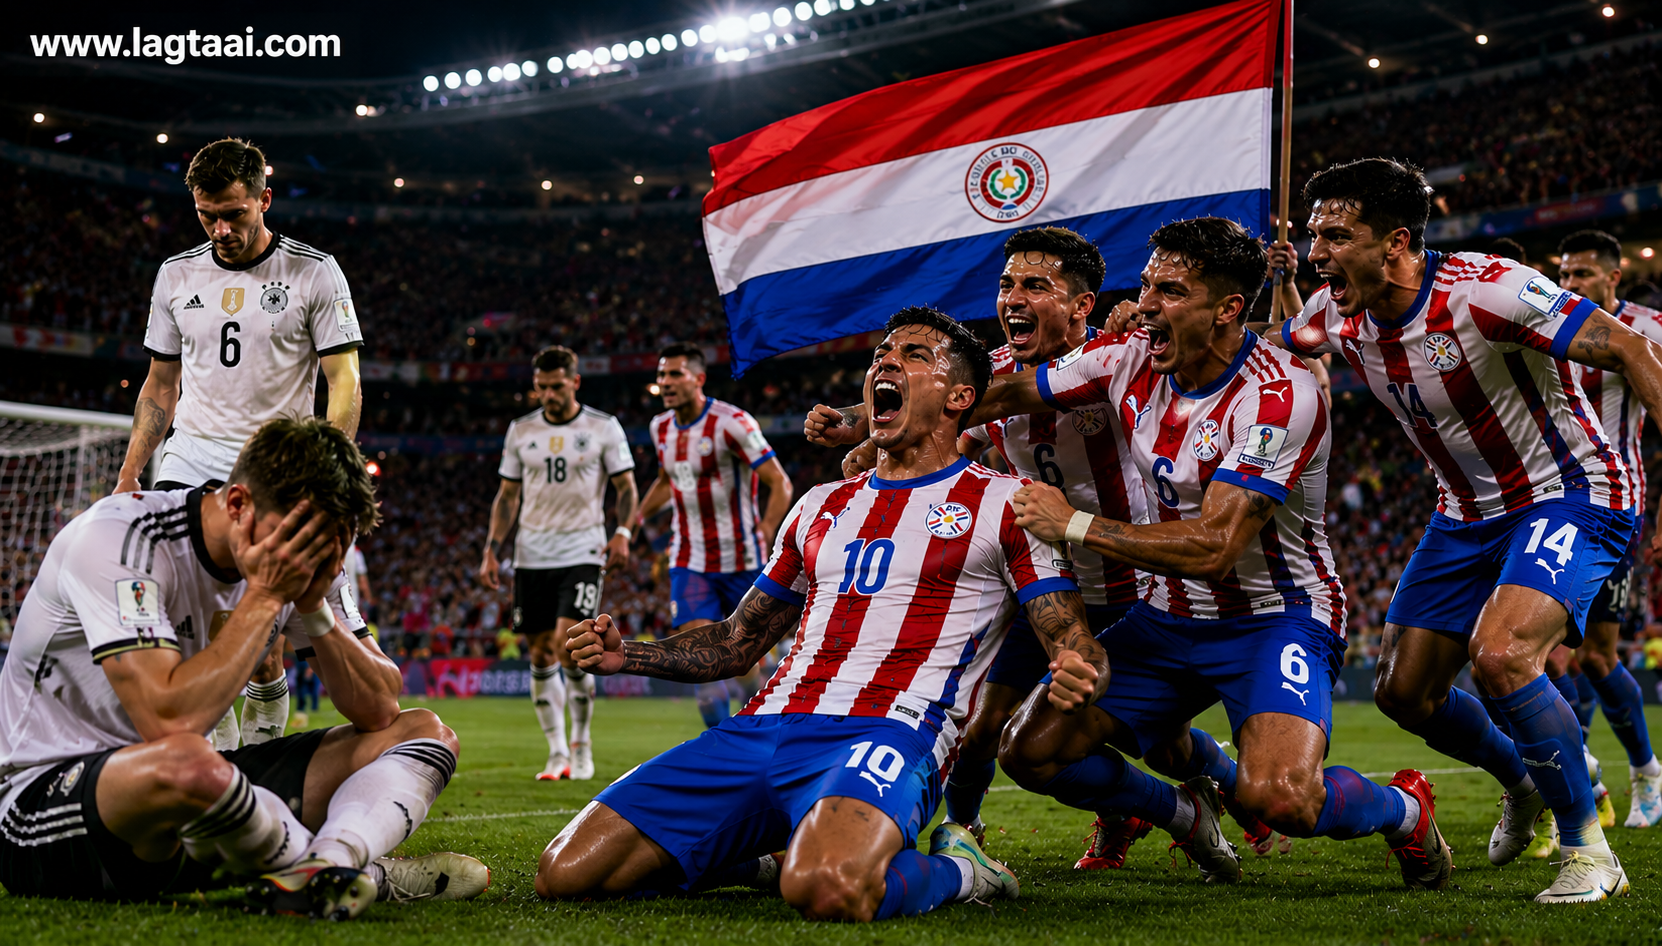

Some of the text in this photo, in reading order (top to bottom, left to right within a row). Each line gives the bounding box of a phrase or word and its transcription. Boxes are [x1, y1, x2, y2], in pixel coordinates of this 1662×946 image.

[219, 321, 242, 368] 6
[1386, 382, 1439, 429] 14
[544, 456, 567, 484] 18
[1033, 443, 1066, 490] 6
[1151, 456, 1180, 508] 6
[1524, 518, 1579, 567] 14
[838, 538, 896, 596] 10
[1280, 643, 1309, 684] 6
[845, 741, 905, 783] 10
